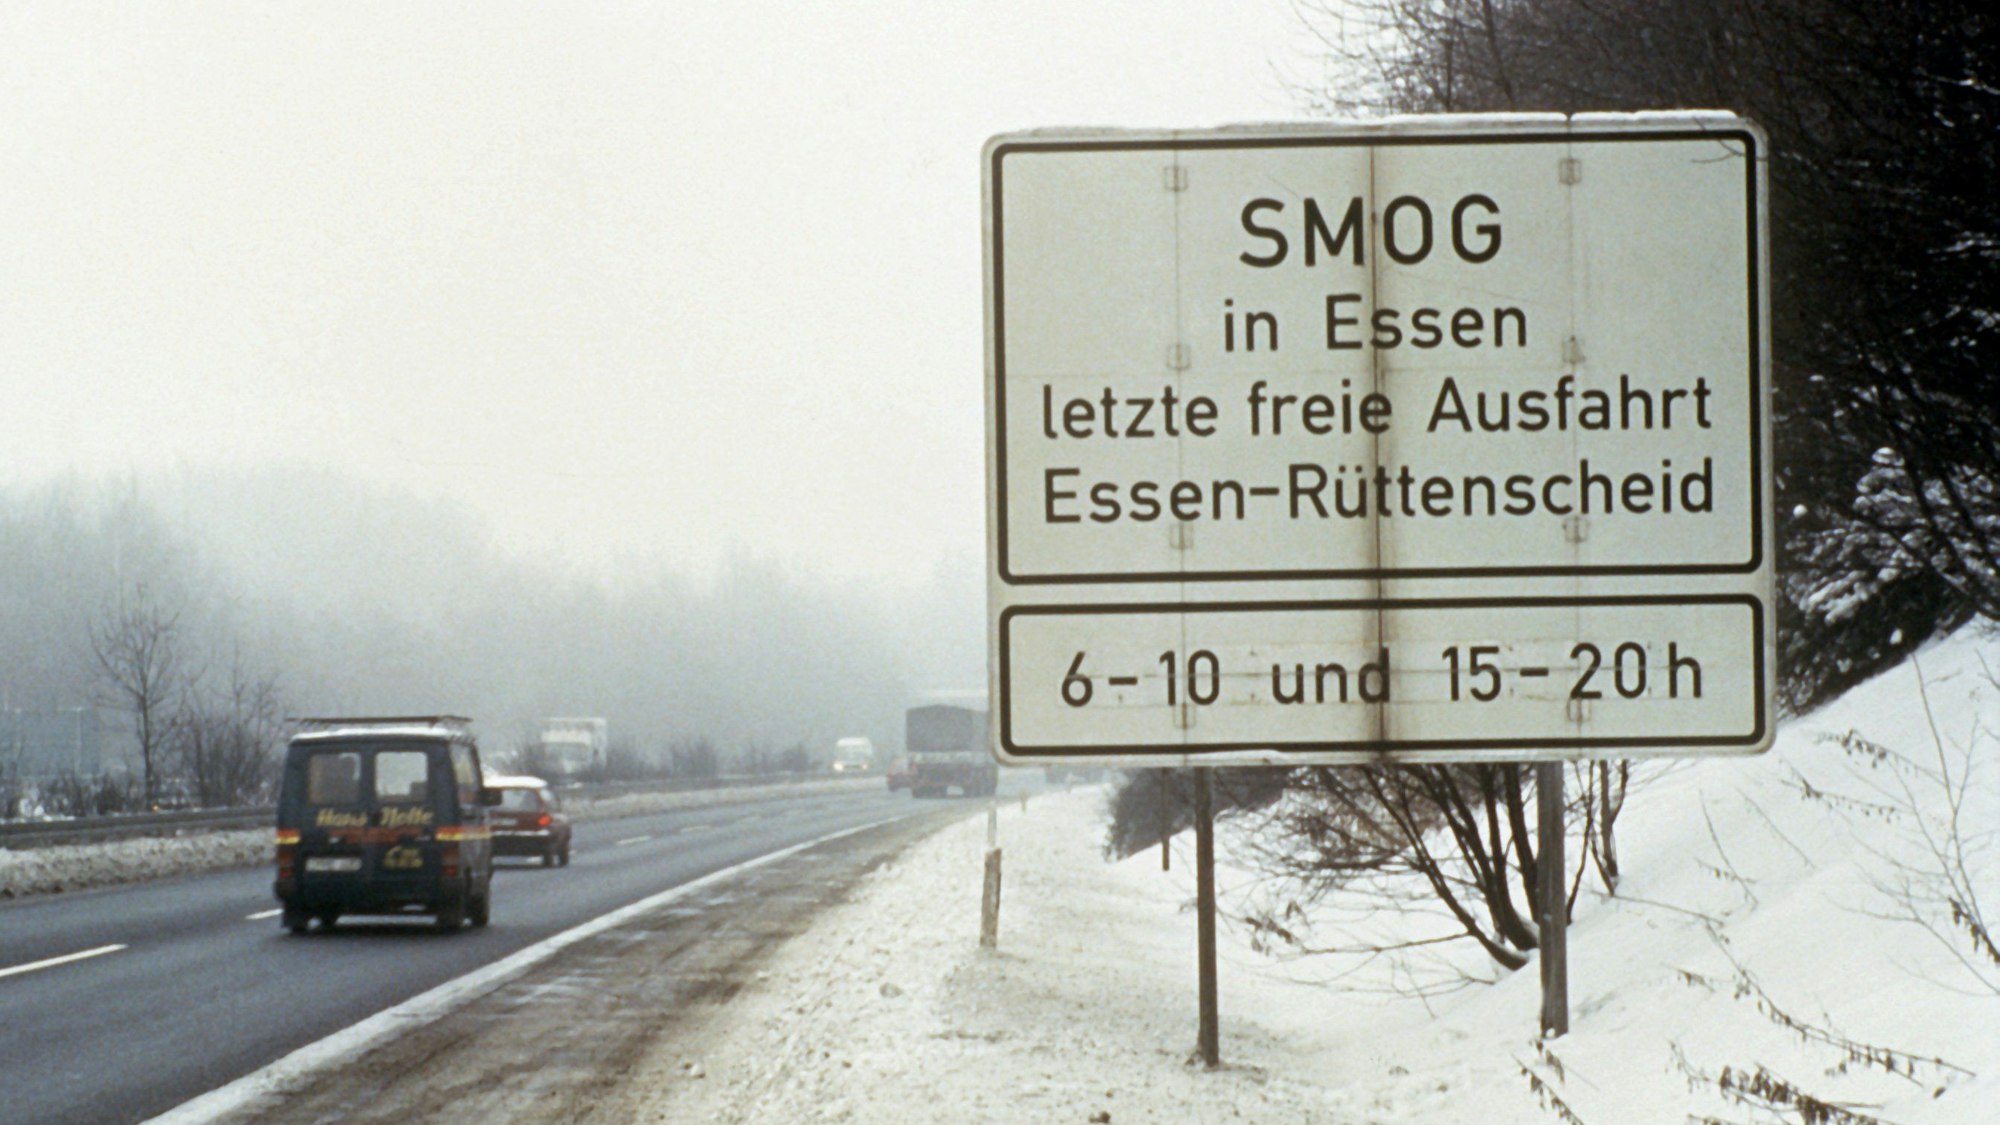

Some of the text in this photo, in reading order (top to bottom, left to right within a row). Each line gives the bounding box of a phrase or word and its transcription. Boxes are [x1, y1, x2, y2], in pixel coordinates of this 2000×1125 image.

[1239, 194, 1503, 268] SMOG
[1224, 294, 1528, 352] in Essen
[1043, 375, 1712, 439] letzte freie Ausfahrt
[1045, 457, 1714, 524] Essen-Rüttenscheid
[1272, 646, 1391, 704] und
